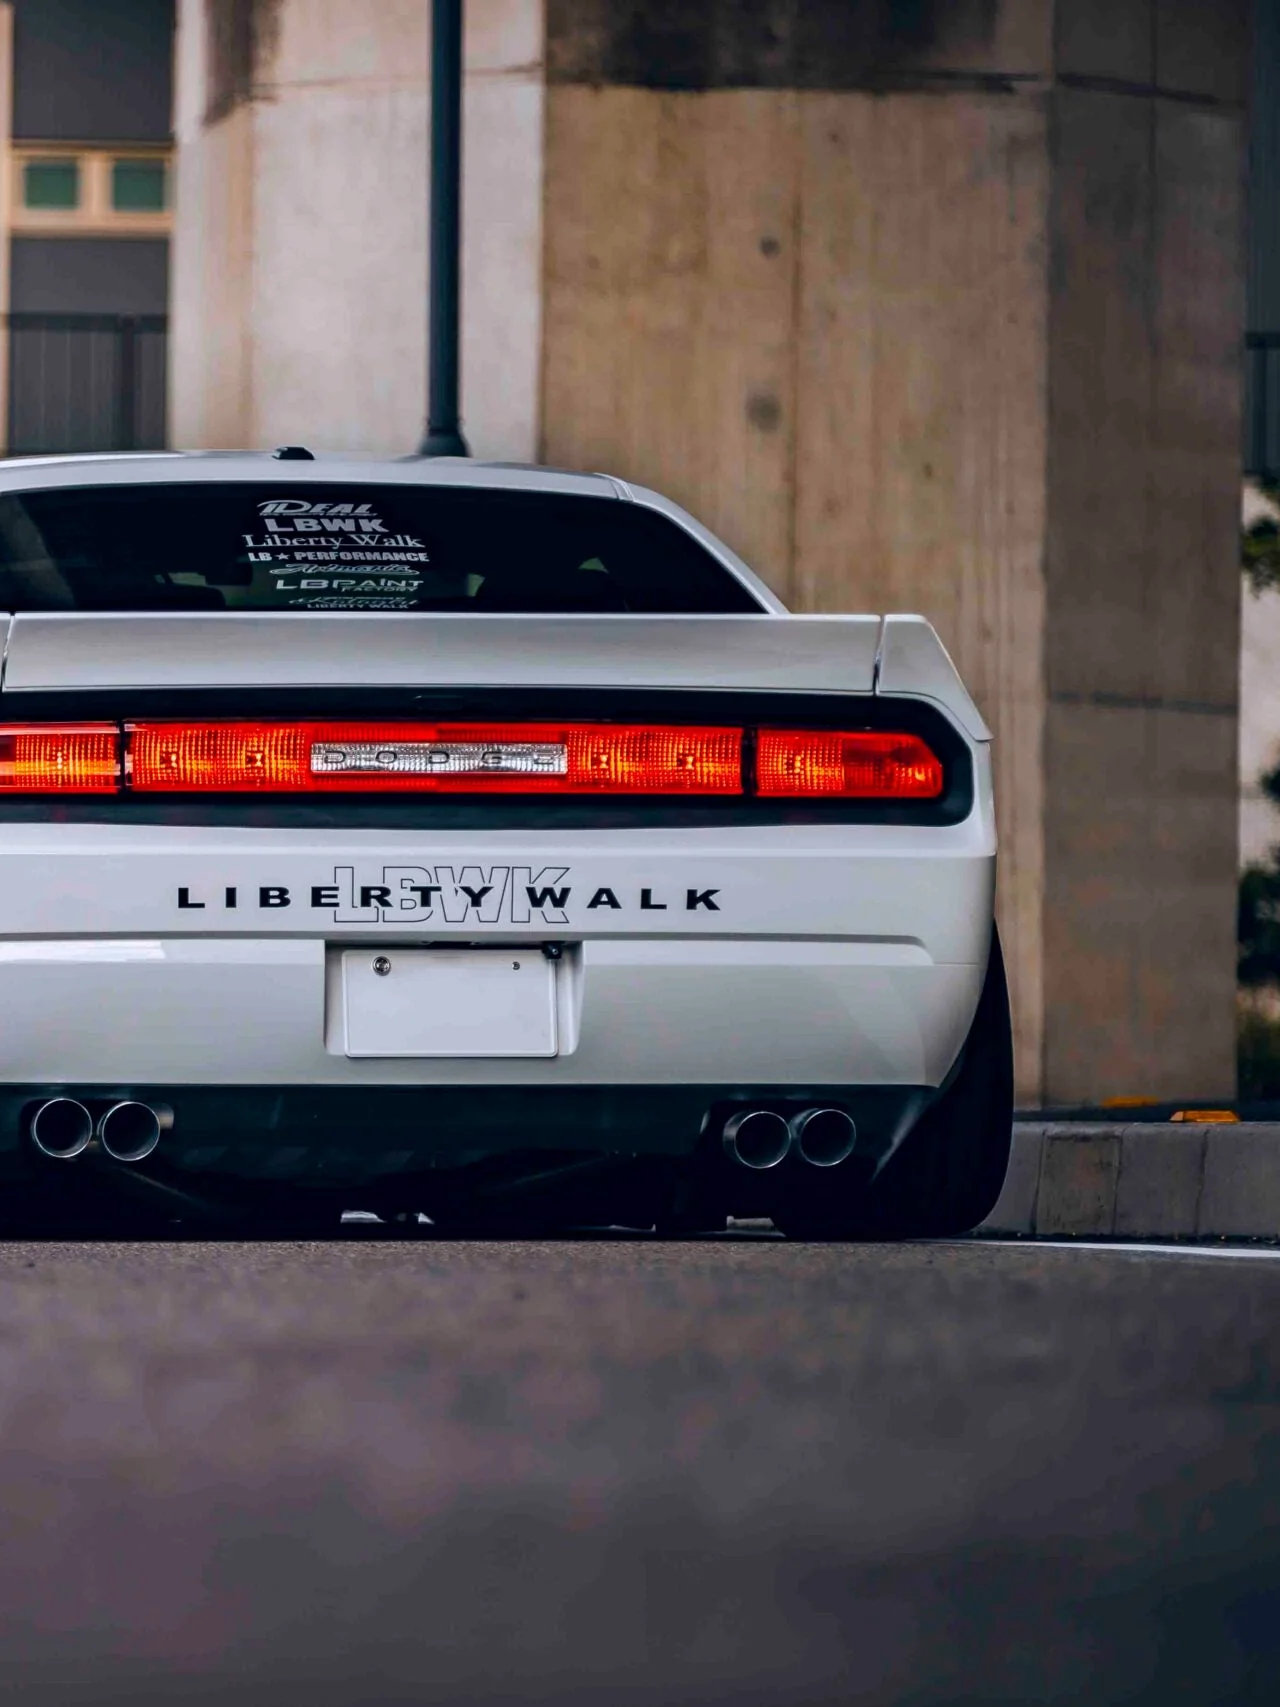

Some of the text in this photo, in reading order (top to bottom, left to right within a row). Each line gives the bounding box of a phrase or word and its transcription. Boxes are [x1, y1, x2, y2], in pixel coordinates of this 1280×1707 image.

[264, 518, 389, 532] LBWK
[242, 534, 425, 549] Liberty Walk
[248, 552, 429, 562] LB PERFORMANCE
[323, 750, 557, 765] DODGE
[177, 885, 722, 912] LIBERTY WALK
